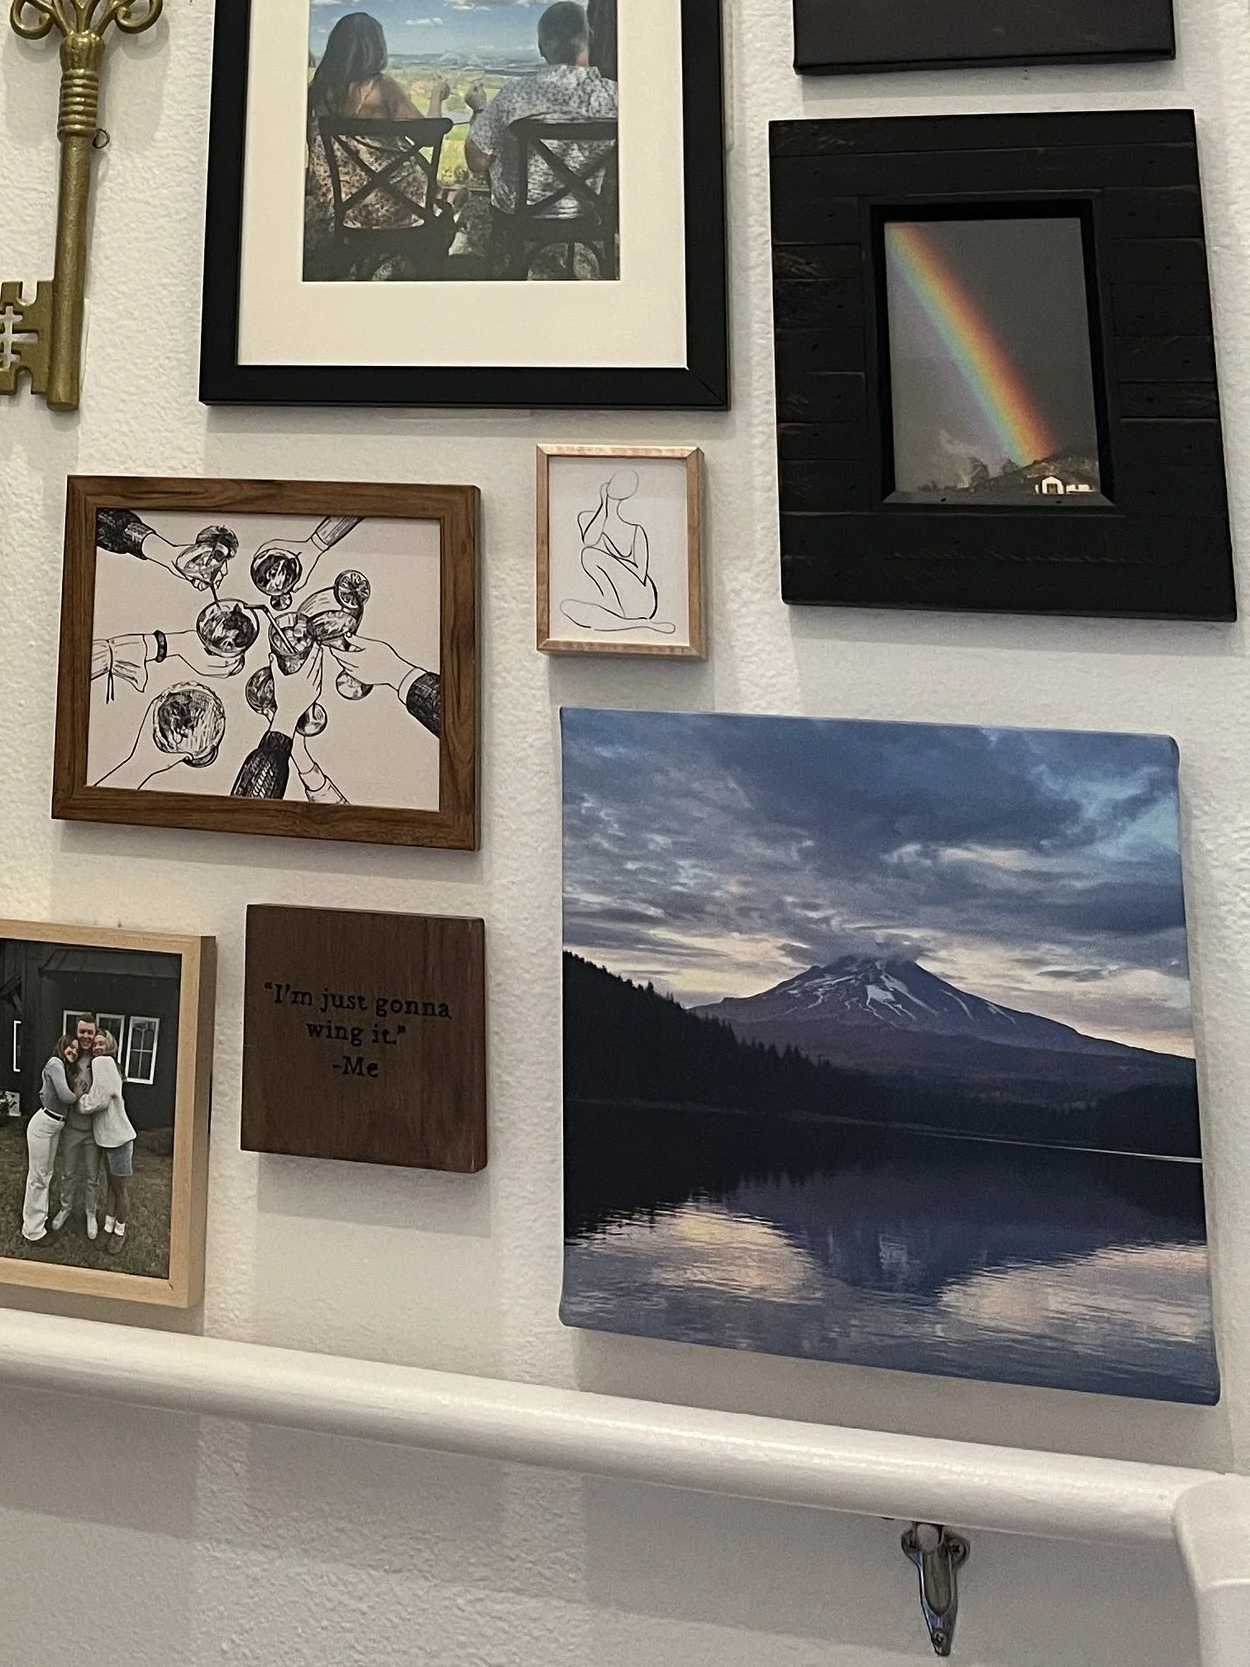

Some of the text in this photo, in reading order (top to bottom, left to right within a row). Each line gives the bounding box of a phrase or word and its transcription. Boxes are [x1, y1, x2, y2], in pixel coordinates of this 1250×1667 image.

[319, 988, 368, 1013] just
[375, 996, 452, 1020] gonna
[306, 1020, 363, 1046] wing
[332, 1055, 379, 1078] -Me
